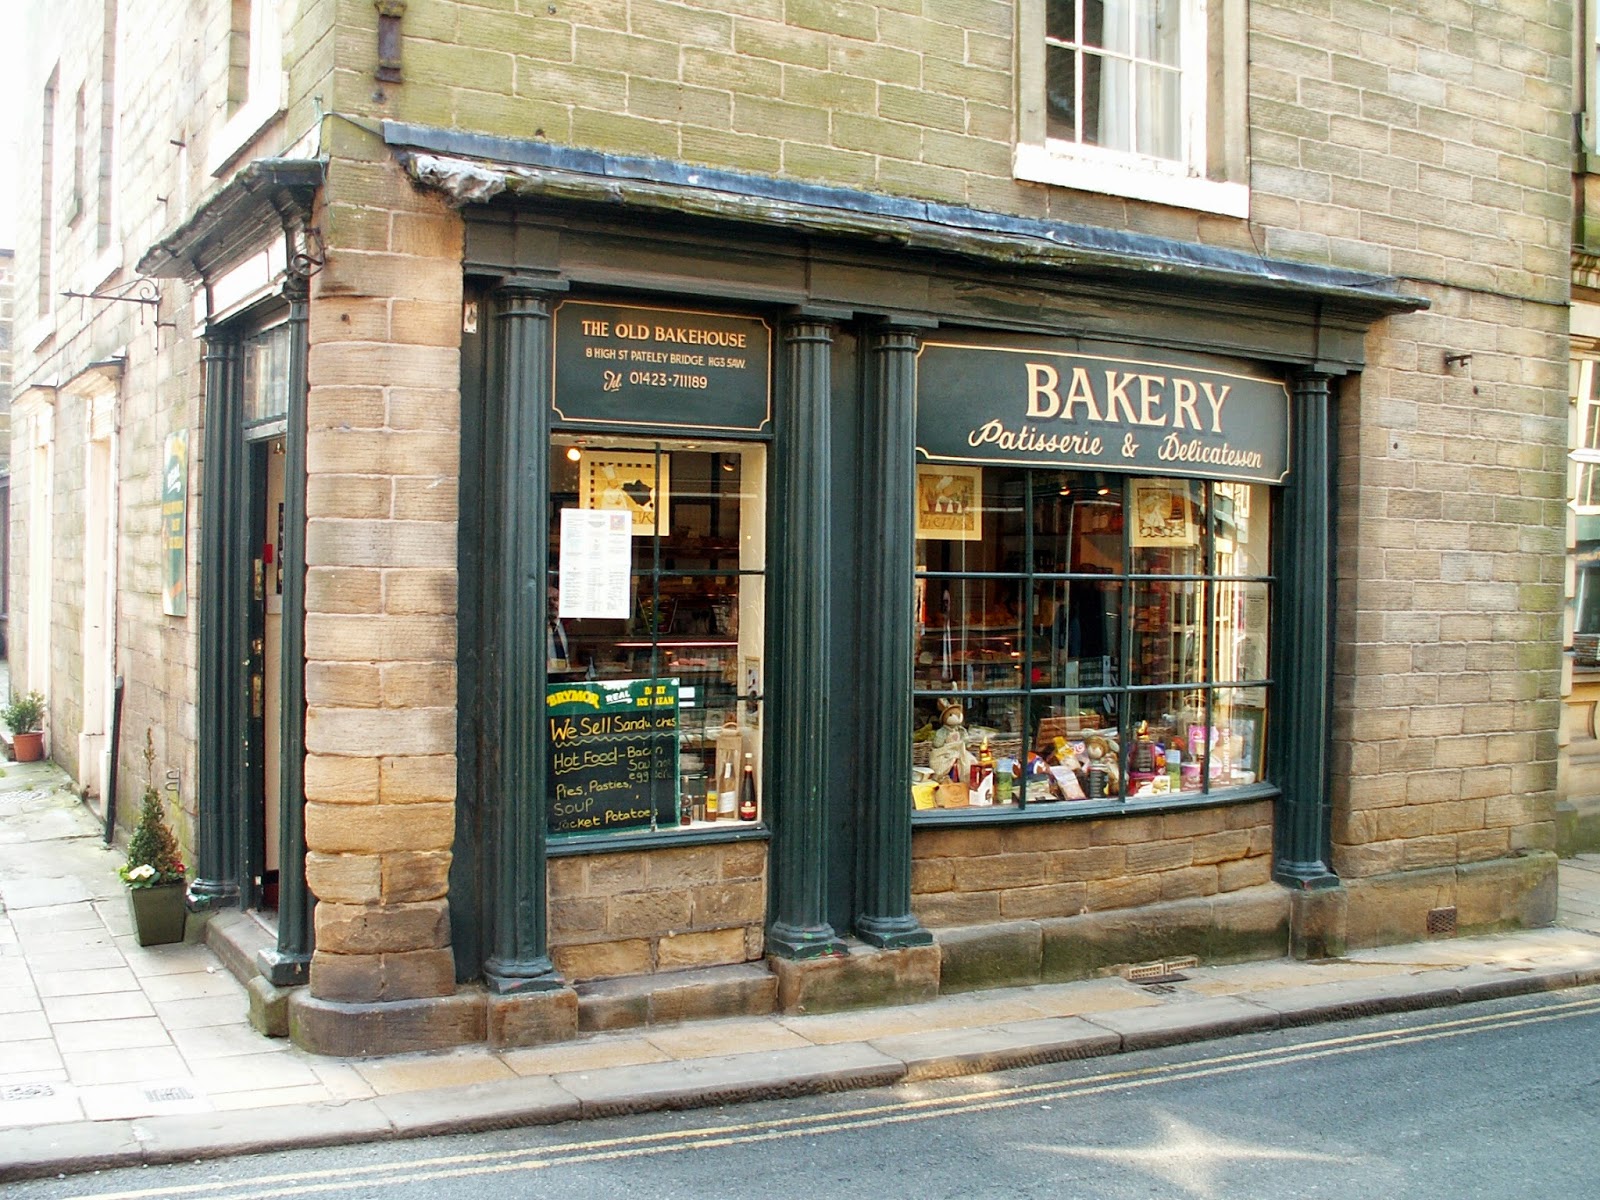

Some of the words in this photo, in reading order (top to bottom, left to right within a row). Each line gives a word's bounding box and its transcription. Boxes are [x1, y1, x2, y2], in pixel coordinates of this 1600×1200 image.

[581, 320, 610, 338] THE
[615, 323, 650, 341] OLD
[654, 327, 747, 349] BAKEHOUSE
[585, 347, 592, 358] 8
[594, 348, 616, 360] HIGH
[618, 349, 629, 361] ST
[631, 350, 669, 363] PATELEY
[708, 356, 725, 368] HG3
[1024, 362, 1232, 435] BAKERY
[967, 418, 1105, 457] Patisserie
[1121, 432, 1140, 458] &
[1157, 432, 1263, 469] Delicatessen
[546, 689, 600, 709] BRYMOR
[605, 691, 630, 702] REAL
[644, 686, 666, 695] DARY
[551, 717, 579, 742] We
[580, 716, 611, 736] Sell
[554, 752, 580, 770] Hot
[627, 745, 663, 759] Bacn
[553, 815, 601, 832] Jacket
